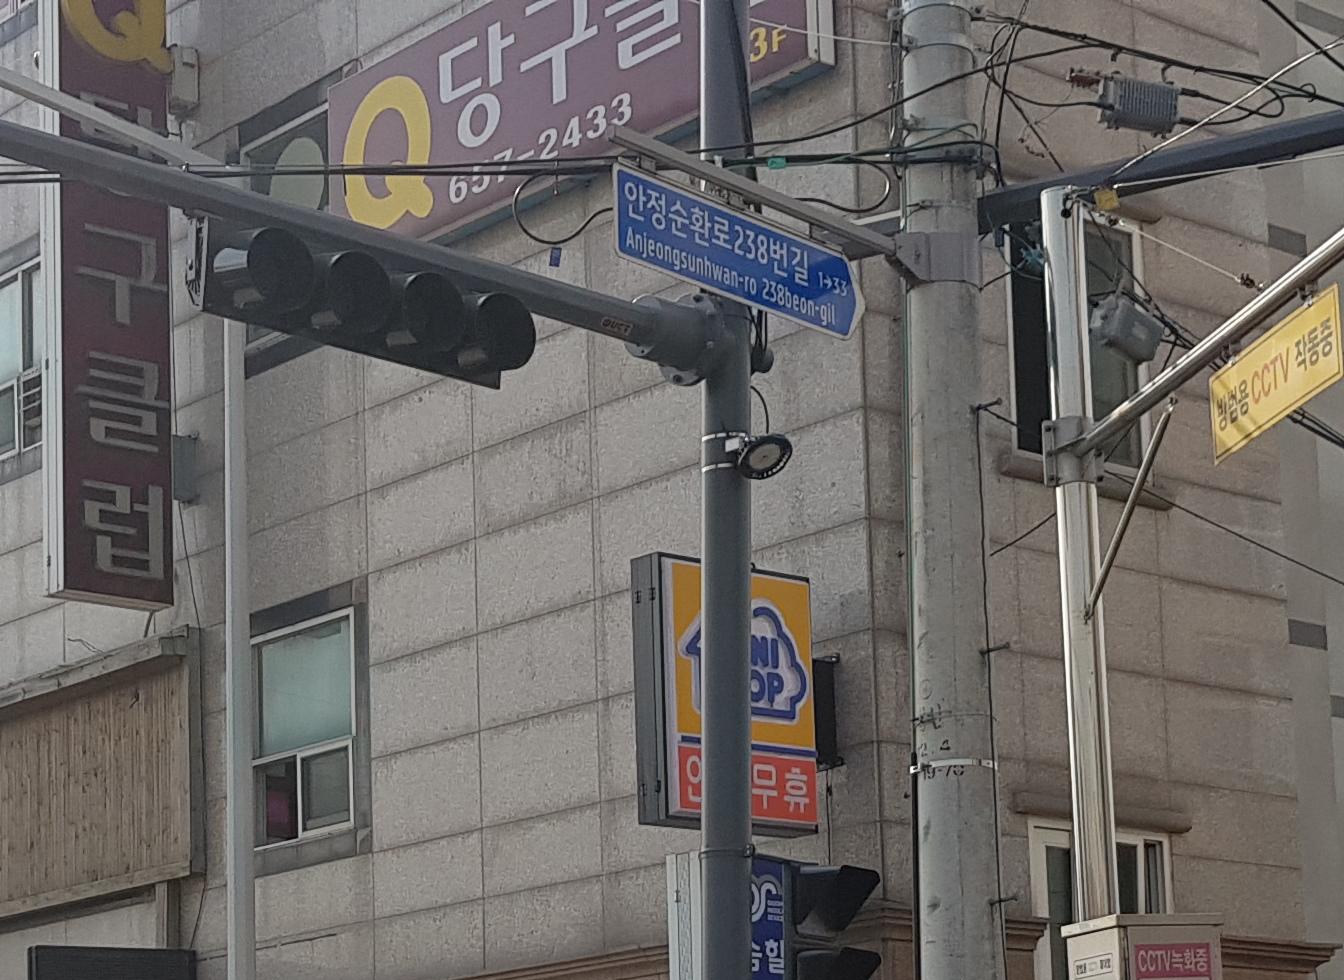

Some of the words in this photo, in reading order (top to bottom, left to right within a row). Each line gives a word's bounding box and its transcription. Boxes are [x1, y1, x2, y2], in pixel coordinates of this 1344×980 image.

[749, 27, 790, 62] 3F
[342, 75, 434, 230] Q
[438, 0, 684, 149] 당구클
[447, 91, 633, 205] 657-2433
[622, 180, 810, 288] 안정순환로238번길
[624, 228, 758, 296] Anjeongsunhwan-ro
[760, 278, 838, 328] 238beon-gil
[1216, 379, 1250, 432] 방범용
[1251, 346, 1290, 406] CCTV
[1294, 317, 1334, 372] 작동중
[750, 671, 785, 706] OP
[751, 634, 779, 669] NI
[1138, 948, 1209, 973] CCTV녹화중
